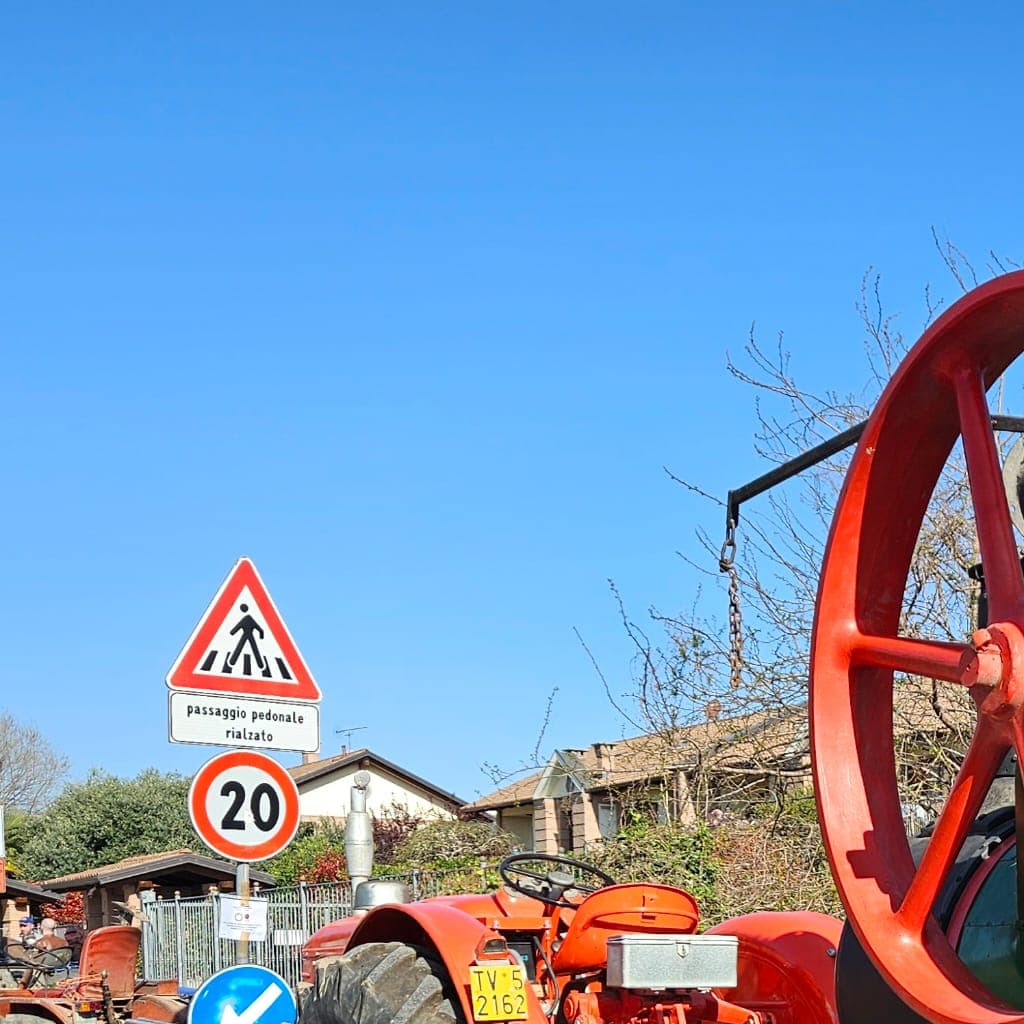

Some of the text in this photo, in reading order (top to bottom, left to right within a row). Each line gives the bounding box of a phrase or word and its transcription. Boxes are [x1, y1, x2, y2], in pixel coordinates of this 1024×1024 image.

[187, 705, 304, 724] passaggio pedonale
[226, 727, 273, 742] rialzato
[220, 780, 280, 832] 20
[473, 970, 523, 992] TV 5
[476, 994, 526, 1016] 2162
